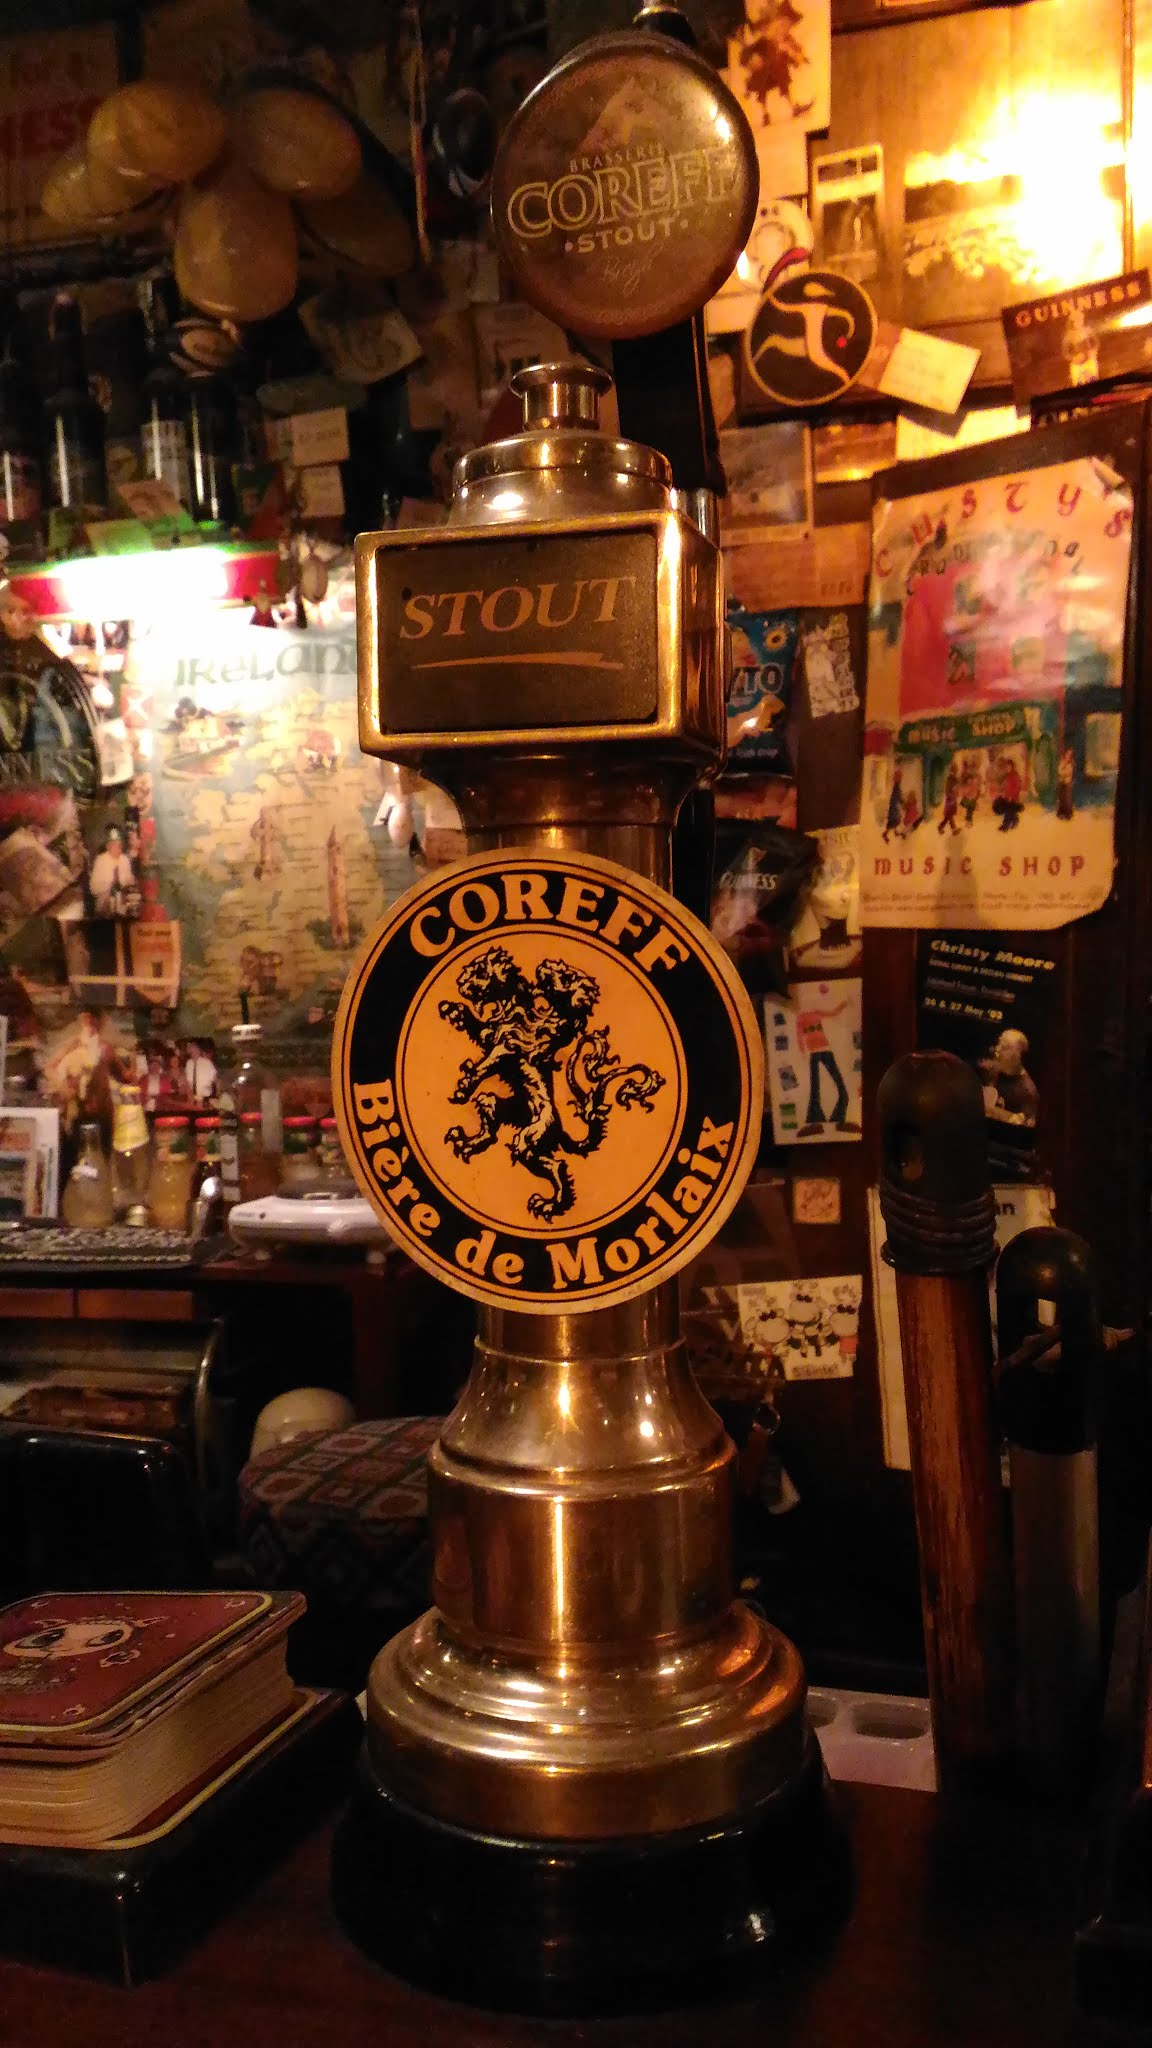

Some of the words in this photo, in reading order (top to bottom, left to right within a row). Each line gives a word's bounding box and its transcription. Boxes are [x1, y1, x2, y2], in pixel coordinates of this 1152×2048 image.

[577, 217, 676, 254] STOUT
[1015, 280, 1142, 328] GUINNESS
[399, 576, 638, 640] STOUT
[999, 855, 1085, 877] SHOP
[409, 873, 690, 974] COREFF
[931, 940, 990, 961] Christy
[995, 952, 1055, 970] Moore
[353, 1078, 442, 1237] Bière
[455, 1230, 526, 1286] de
[545, 1115, 735, 1289] Morlaix
